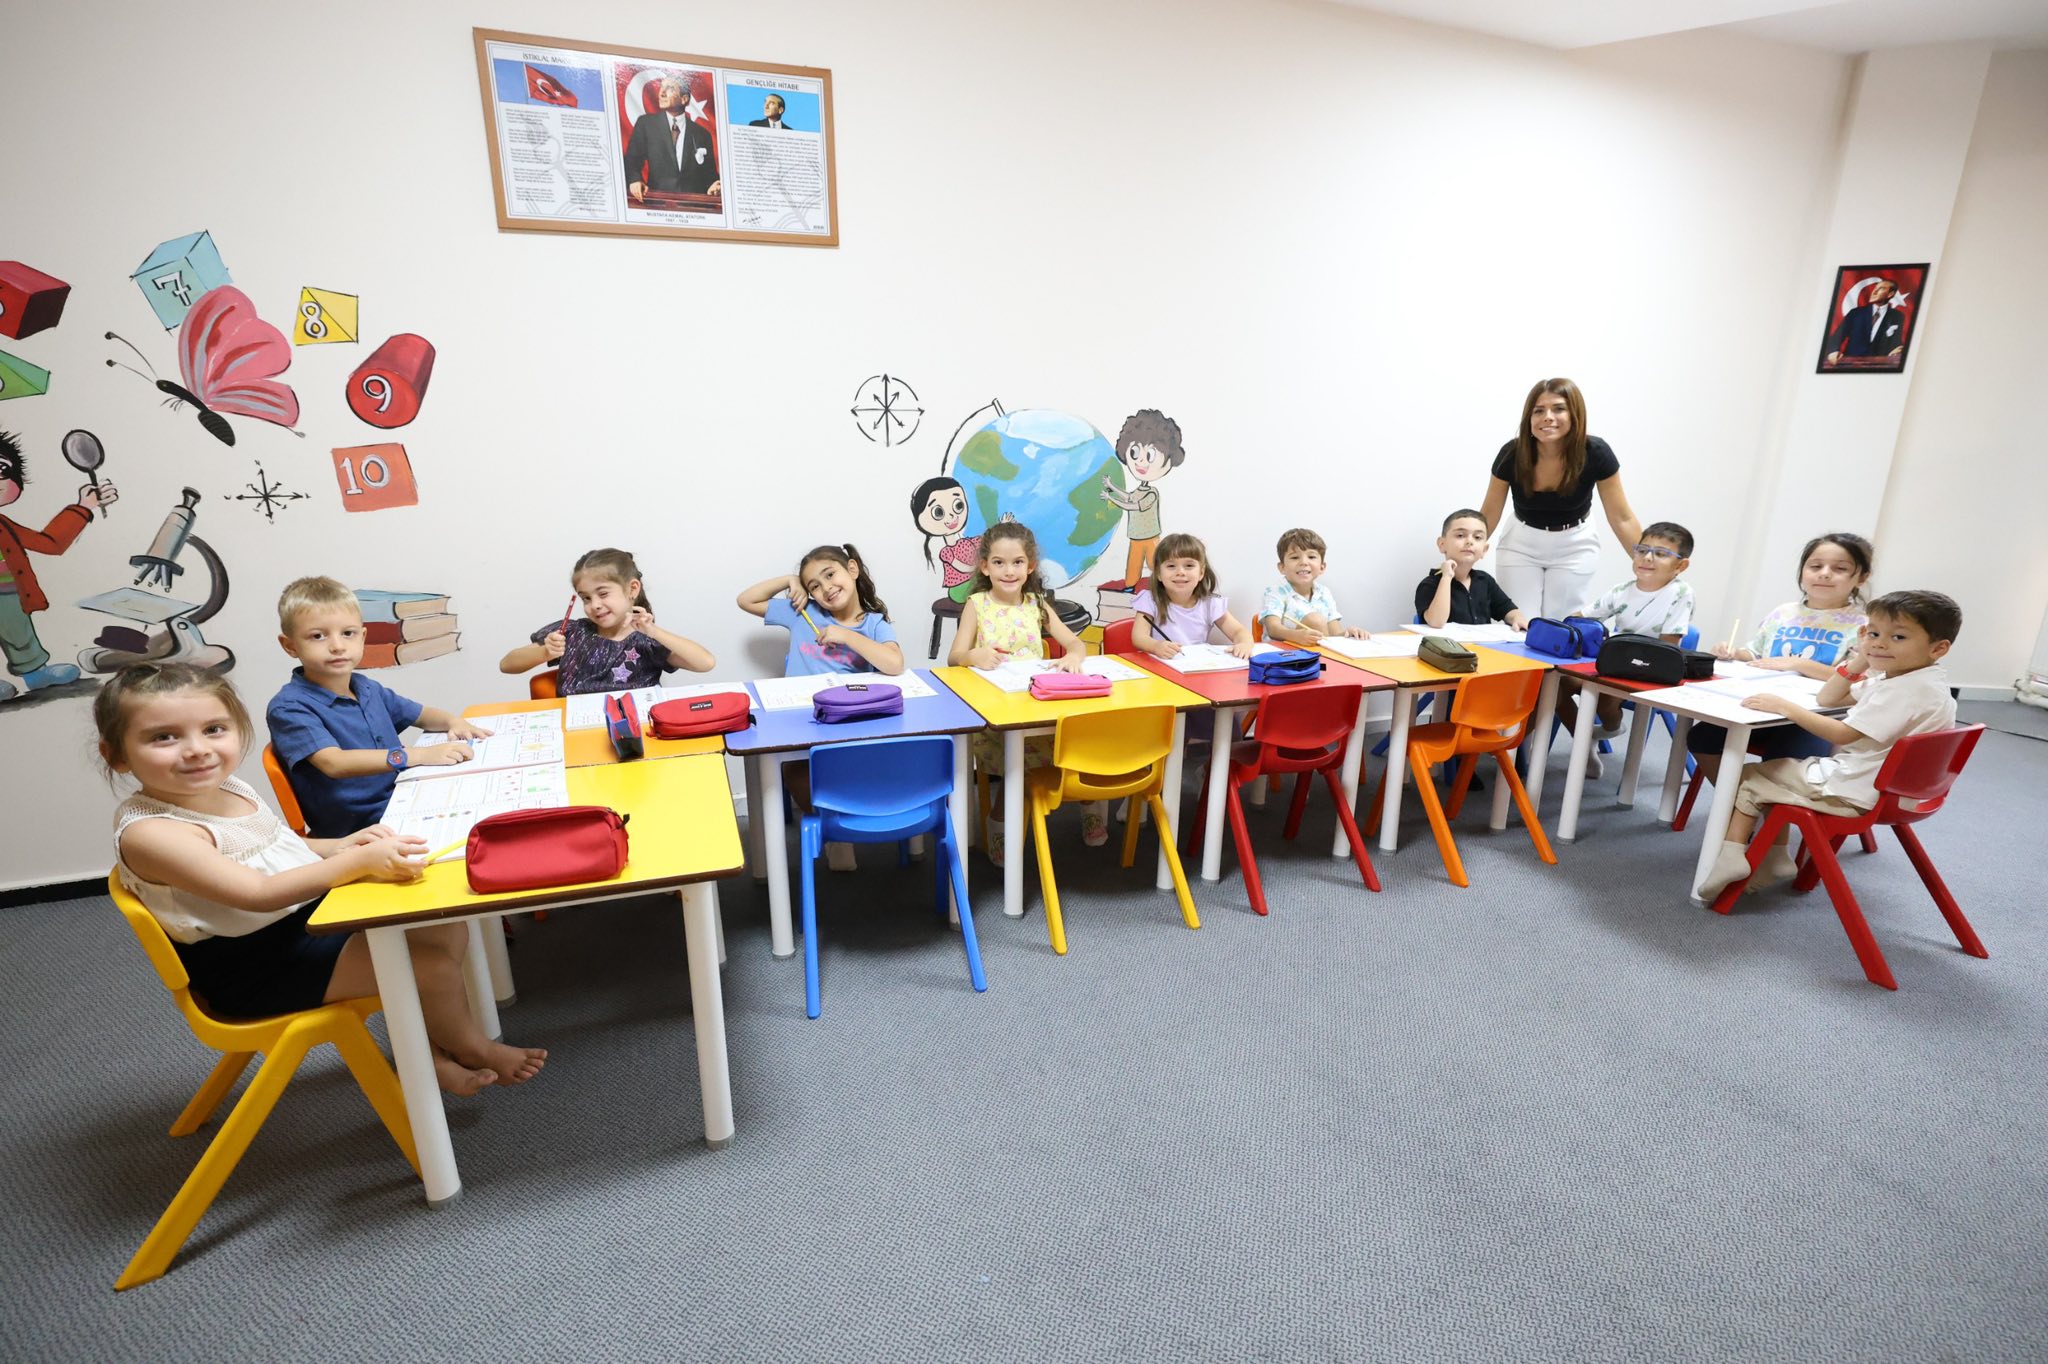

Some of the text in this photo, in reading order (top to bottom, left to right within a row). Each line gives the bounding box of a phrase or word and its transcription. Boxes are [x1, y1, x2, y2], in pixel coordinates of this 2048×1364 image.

[746, 78, 800, 90] GENÇLİĞE HİTABE
[152, 271, 192, 307] 7
[301, 301, 328, 339] 8
[362, 374, 392, 414] 9
[340, 454, 391, 495] 10
[1775, 626, 1844, 645] SONIC
